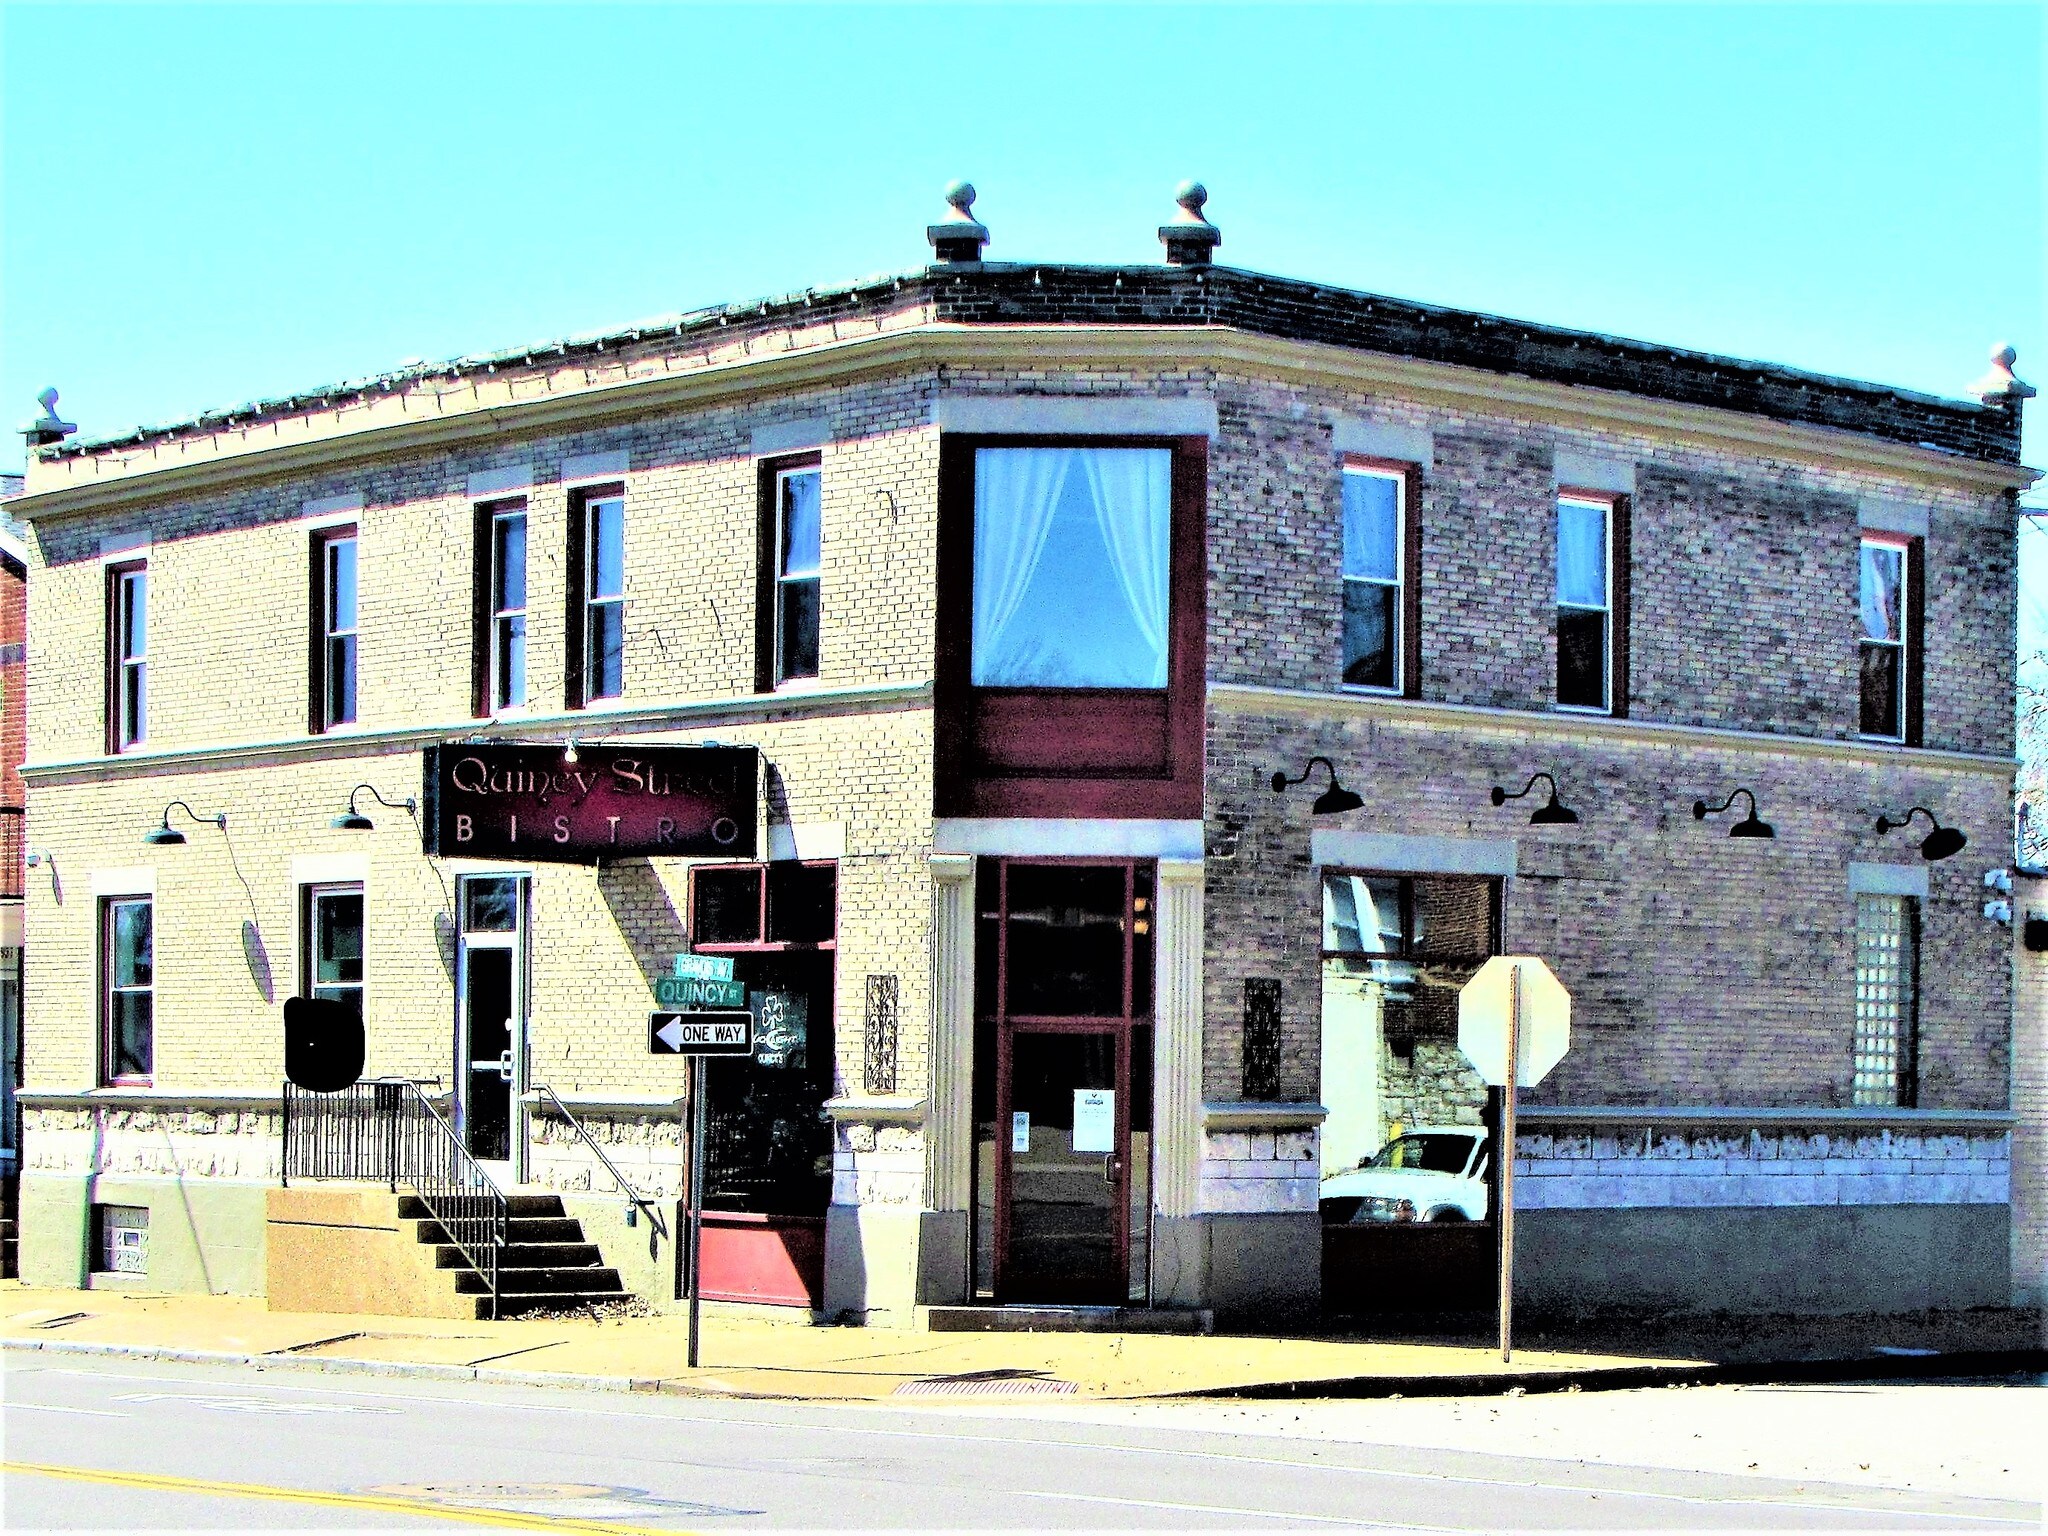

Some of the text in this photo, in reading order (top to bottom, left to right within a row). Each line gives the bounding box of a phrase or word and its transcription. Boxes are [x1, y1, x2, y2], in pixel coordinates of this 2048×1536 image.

[452, 757, 597, 805] Quincy
[456, 814, 739, 844] BISTRO
[661, 981, 727, 1004] QUINCY
[682, 1025, 710, 1042] ONE
[714, 1025, 742, 1042] WAY
